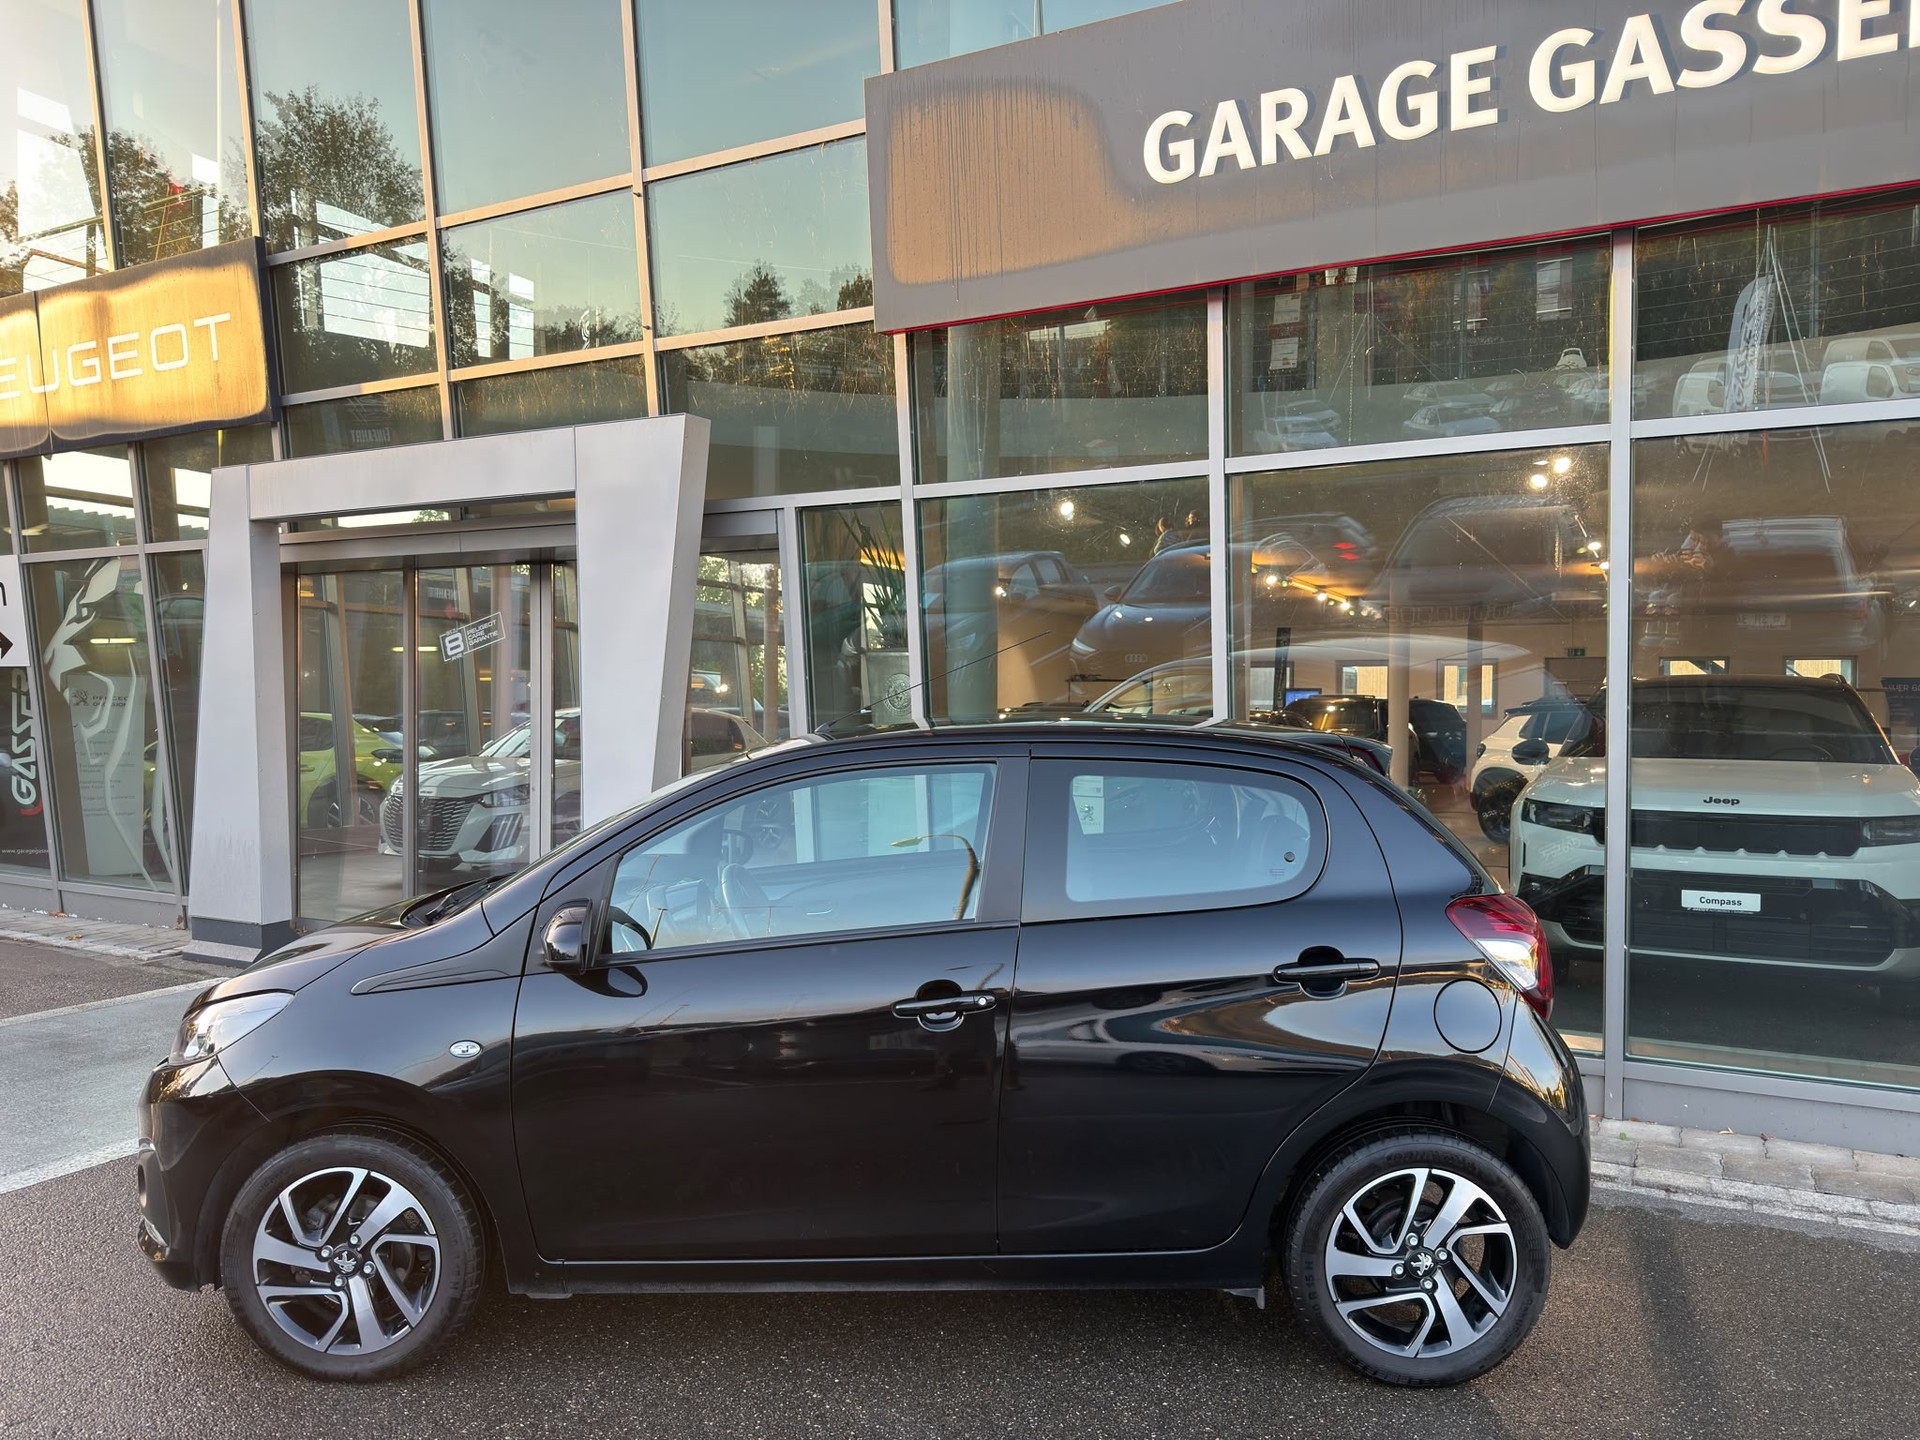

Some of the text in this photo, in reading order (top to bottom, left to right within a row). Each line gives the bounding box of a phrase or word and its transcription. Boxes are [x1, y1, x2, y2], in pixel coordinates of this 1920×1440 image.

[1143, 0, 1920, 185] GARAGE GASSE
[467, 620, 496, 635] PEUGEOT
[468, 630, 485, 641] CARE
[469, 631, 498, 646] GARANTIE
[445, 632, 464, 656] 8
[11, 668, 37, 806] GASSER
[1703, 796, 1741, 806] Jeep
[1699, 896, 1742, 907] Compass
